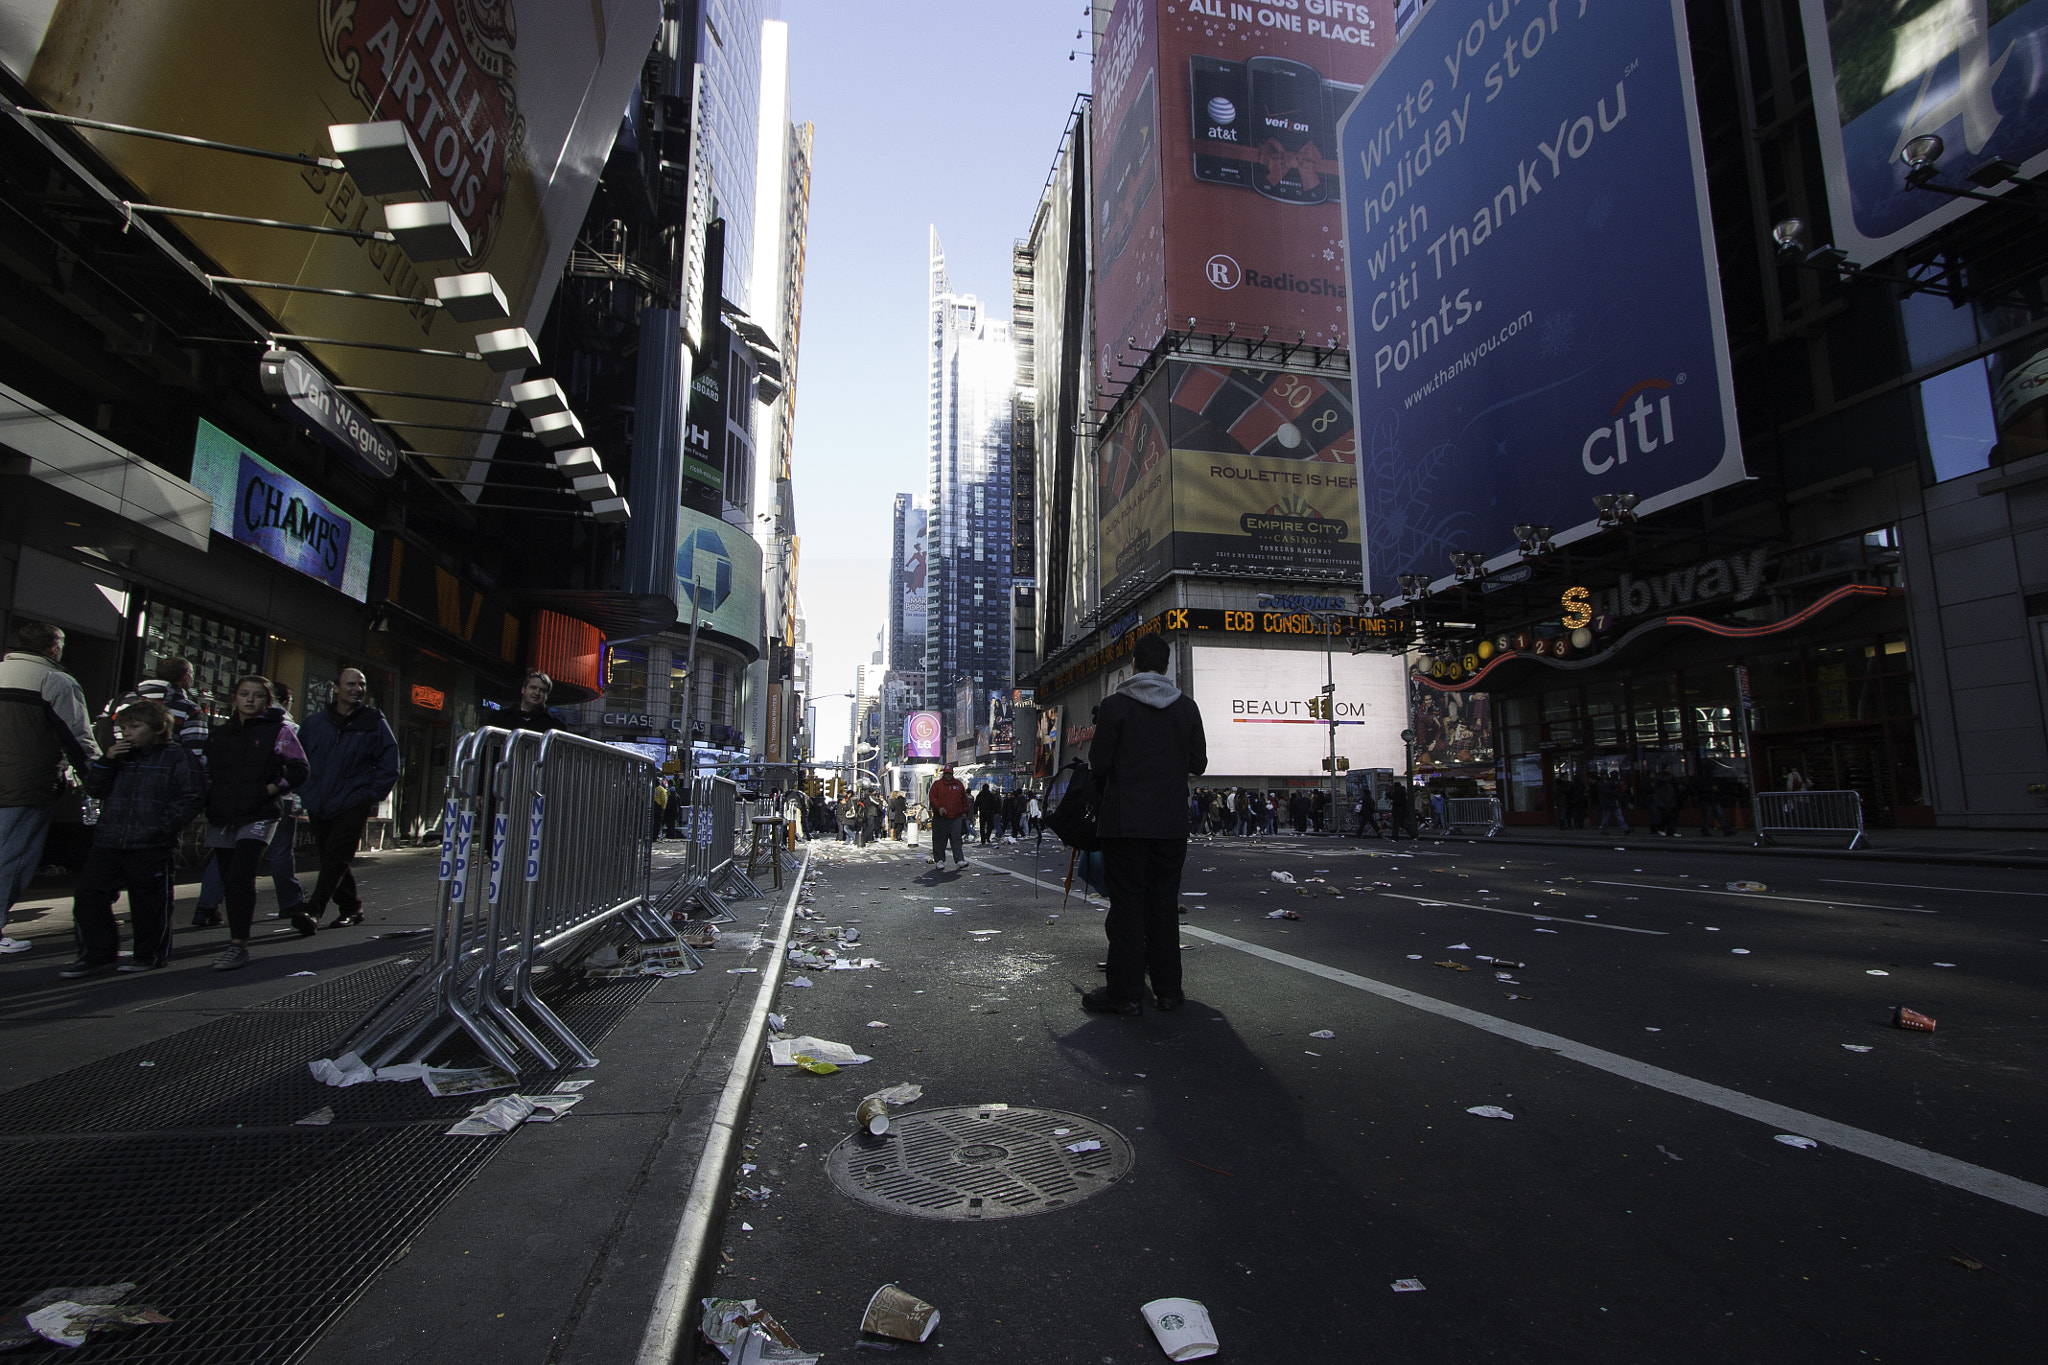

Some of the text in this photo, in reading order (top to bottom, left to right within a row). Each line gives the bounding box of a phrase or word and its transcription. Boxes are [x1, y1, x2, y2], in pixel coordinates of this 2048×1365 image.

[1188, 0, 1226, 18] ALL
[1230, 3, 1253, 23] IN
[1257, 9, 1302, 33] ONE
[1307, 18, 1376, 47] PLACE.
[1305, 0, 1376, 29] GIFTS,
[1101, 0, 1144, 118] MOBILE
[1360, 0, 1521, 180] Write you
[365, 16, 481, 218] ARTOIS
[1208, 126, 1238, 142] at&t
[1265, 117, 1309, 132] verizon
[1279, 179, 1302, 187] SAMSUNG
[1364, 92, 1471, 234] holiday
[1371, 260, 1419, 332] Citi
[1426, 80, 1627, 281] ThankYou
[1368, 203, 1429, 282] with
[1375, 287, 1483, 389] Points.
[1404, 310, 1533, 409] www.thankyou.com
[702, 375, 719, 392] 100%
[1273, 374, 1312, 409] 30
[289, 358, 393, 466] Van Wagner
[1137, 423, 1148, 453] 8
[1311, 409, 1338, 433] 8
[1582, 393, 1675, 476] citi
[1137, 474, 1162, 507] NUMBER
[1210, 465, 1303, 484] ROULETTE
[1306, 474, 1322, 486] IS
[244, 475, 340, 571] CHAMPS
[1246, 517, 1304, 532] EMPIRE
[1259, 544, 1332, 555] YONKERS RACEWAY
[1273, 534, 1317, 545] CASINO
[1560, 548, 1768, 630] Subway
[1225, 610, 1255, 632] ECB
[1433, 663, 1442, 674] N
[1465, 658, 1474, 666] R
[1498, 636, 1508, 650] S
[1518, 636, 1524, 648] 1
[1535, 640, 1545, 654] 2
[1556, 641, 1565, 655] 3
[1595, 615, 1607, 630] 7
[603, 712, 654, 727] CHASE
[916, 740, 932, 749] LG
[440, 802, 458, 878] NYPD
[452, 815, 472, 899] NYPD
[489, 817, 507, 900] NYPD
[526, 798, 545, 878] NYPD
